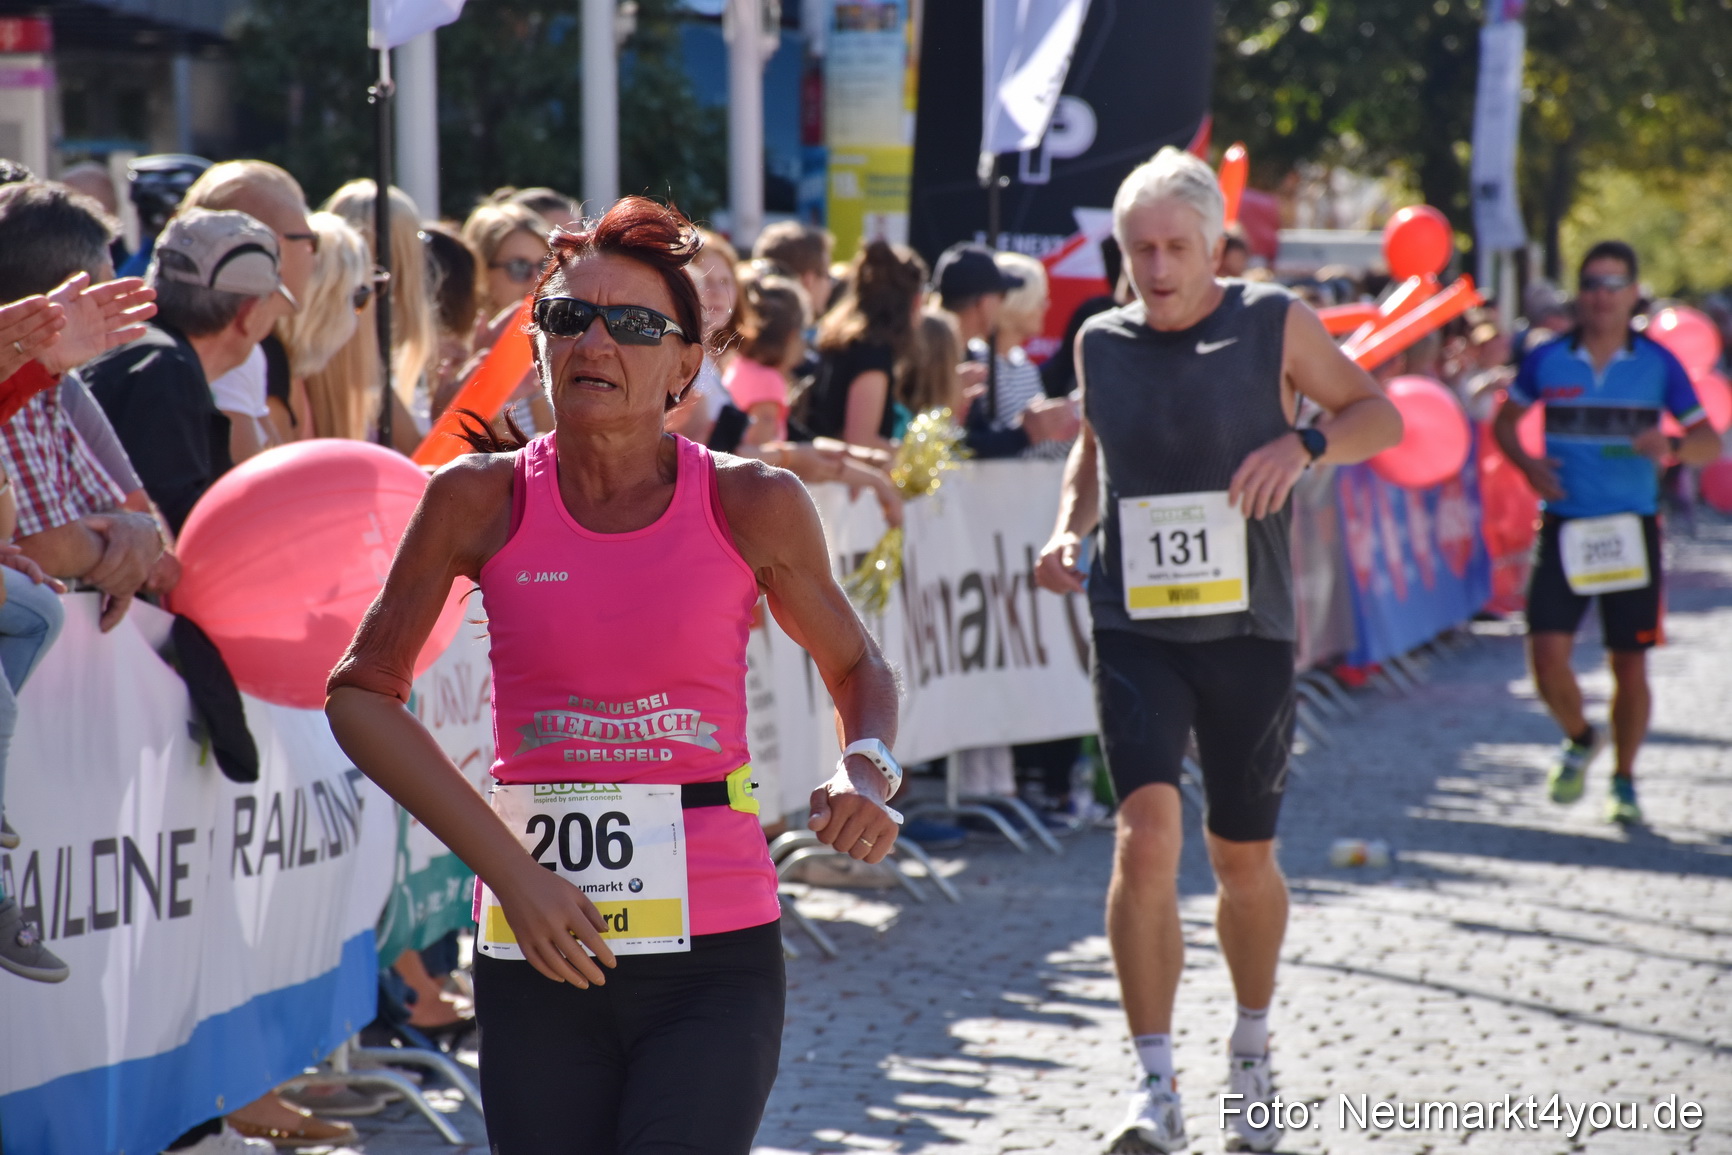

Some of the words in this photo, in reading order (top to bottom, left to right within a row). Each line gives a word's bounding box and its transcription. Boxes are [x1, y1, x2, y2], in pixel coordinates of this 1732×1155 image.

[1149, 528, 1208, 567] 131
[534, 571, 569, 582] JAKO
[568, 693, 669, 715] BRAUEREI
[541, 713, 694, 740] HELDRICH
[563, 749, 673, 762] EDELSFELD
[534, 795, 558, 804] inspired
[558, 795, 567, 804] by
[567, 794, 588, 802] smart
[526, 811, 633, 871] 206
[578, 881, 623, 893] umarkt
